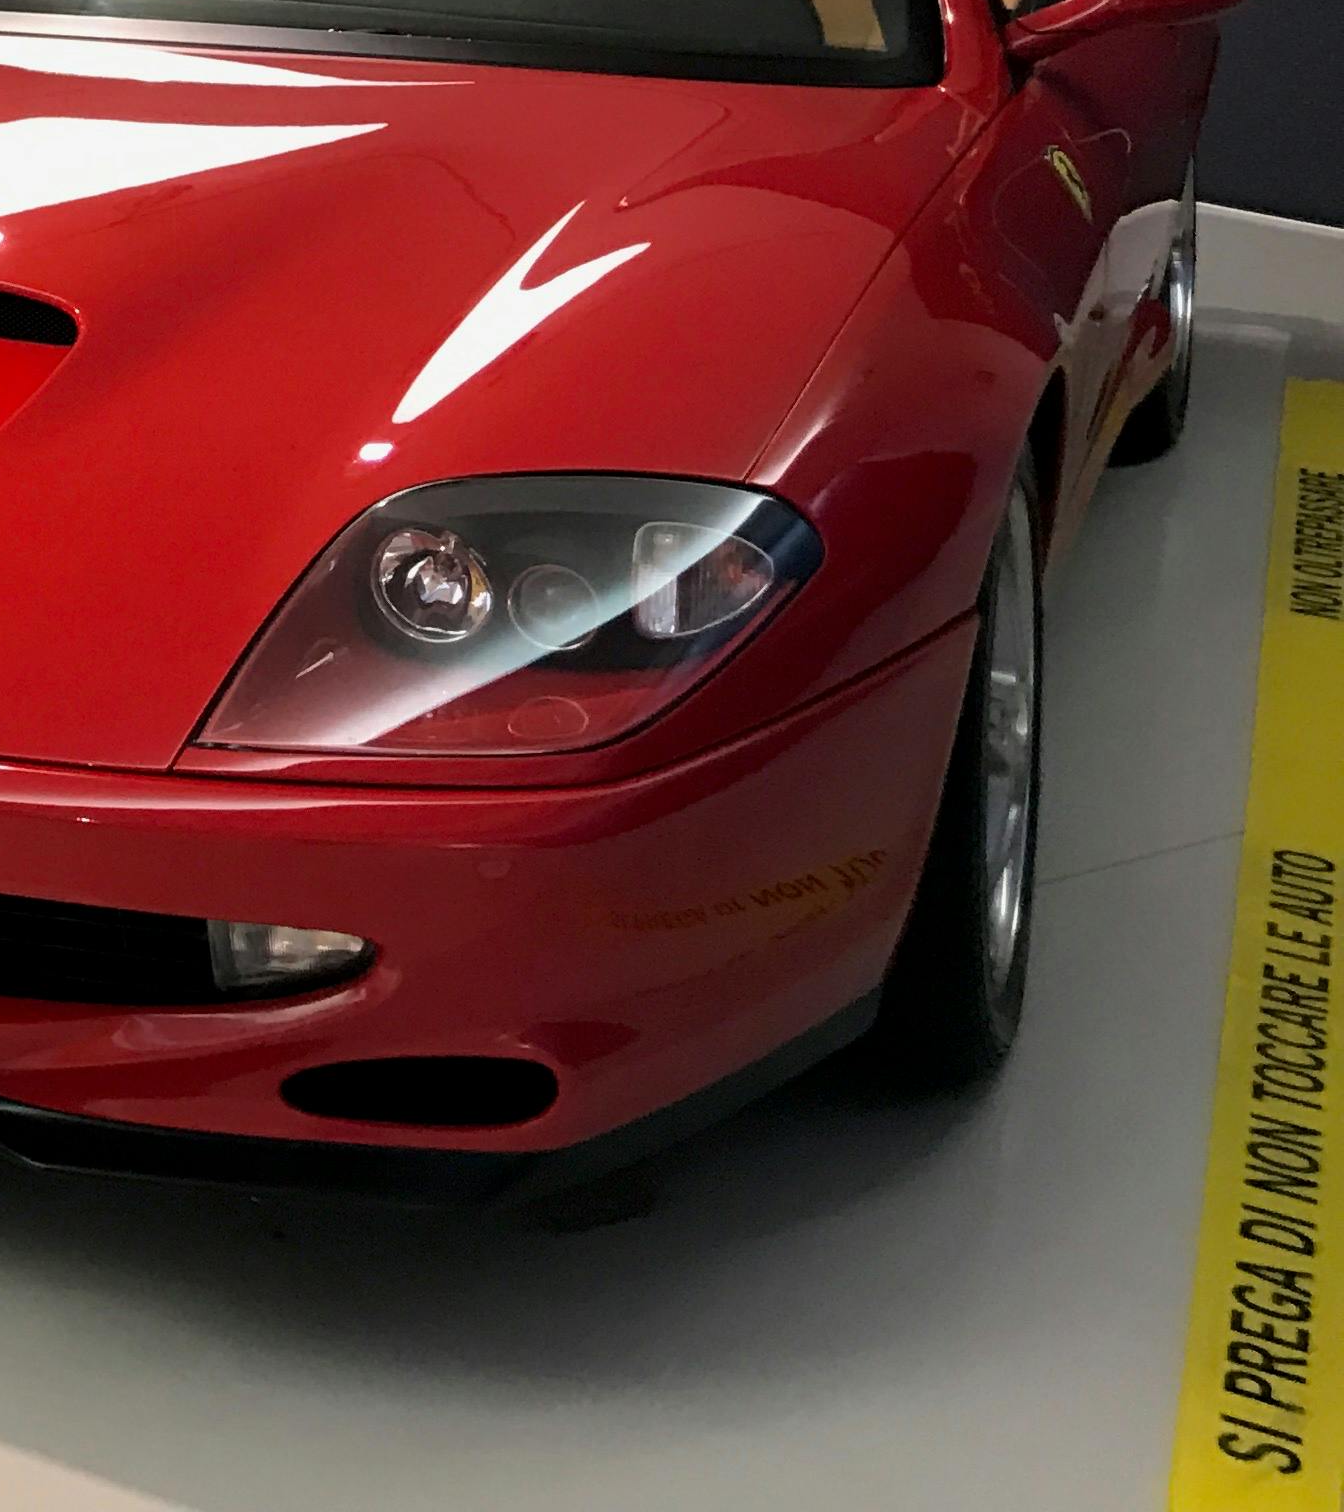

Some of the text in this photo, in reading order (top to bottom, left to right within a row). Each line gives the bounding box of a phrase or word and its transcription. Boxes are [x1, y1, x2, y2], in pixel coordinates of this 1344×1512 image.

[1290, 578, 1342, 620] NON
[1217, 849, 1336, 1475] SI PREGA DI NON TOCCARE LE AUTO
